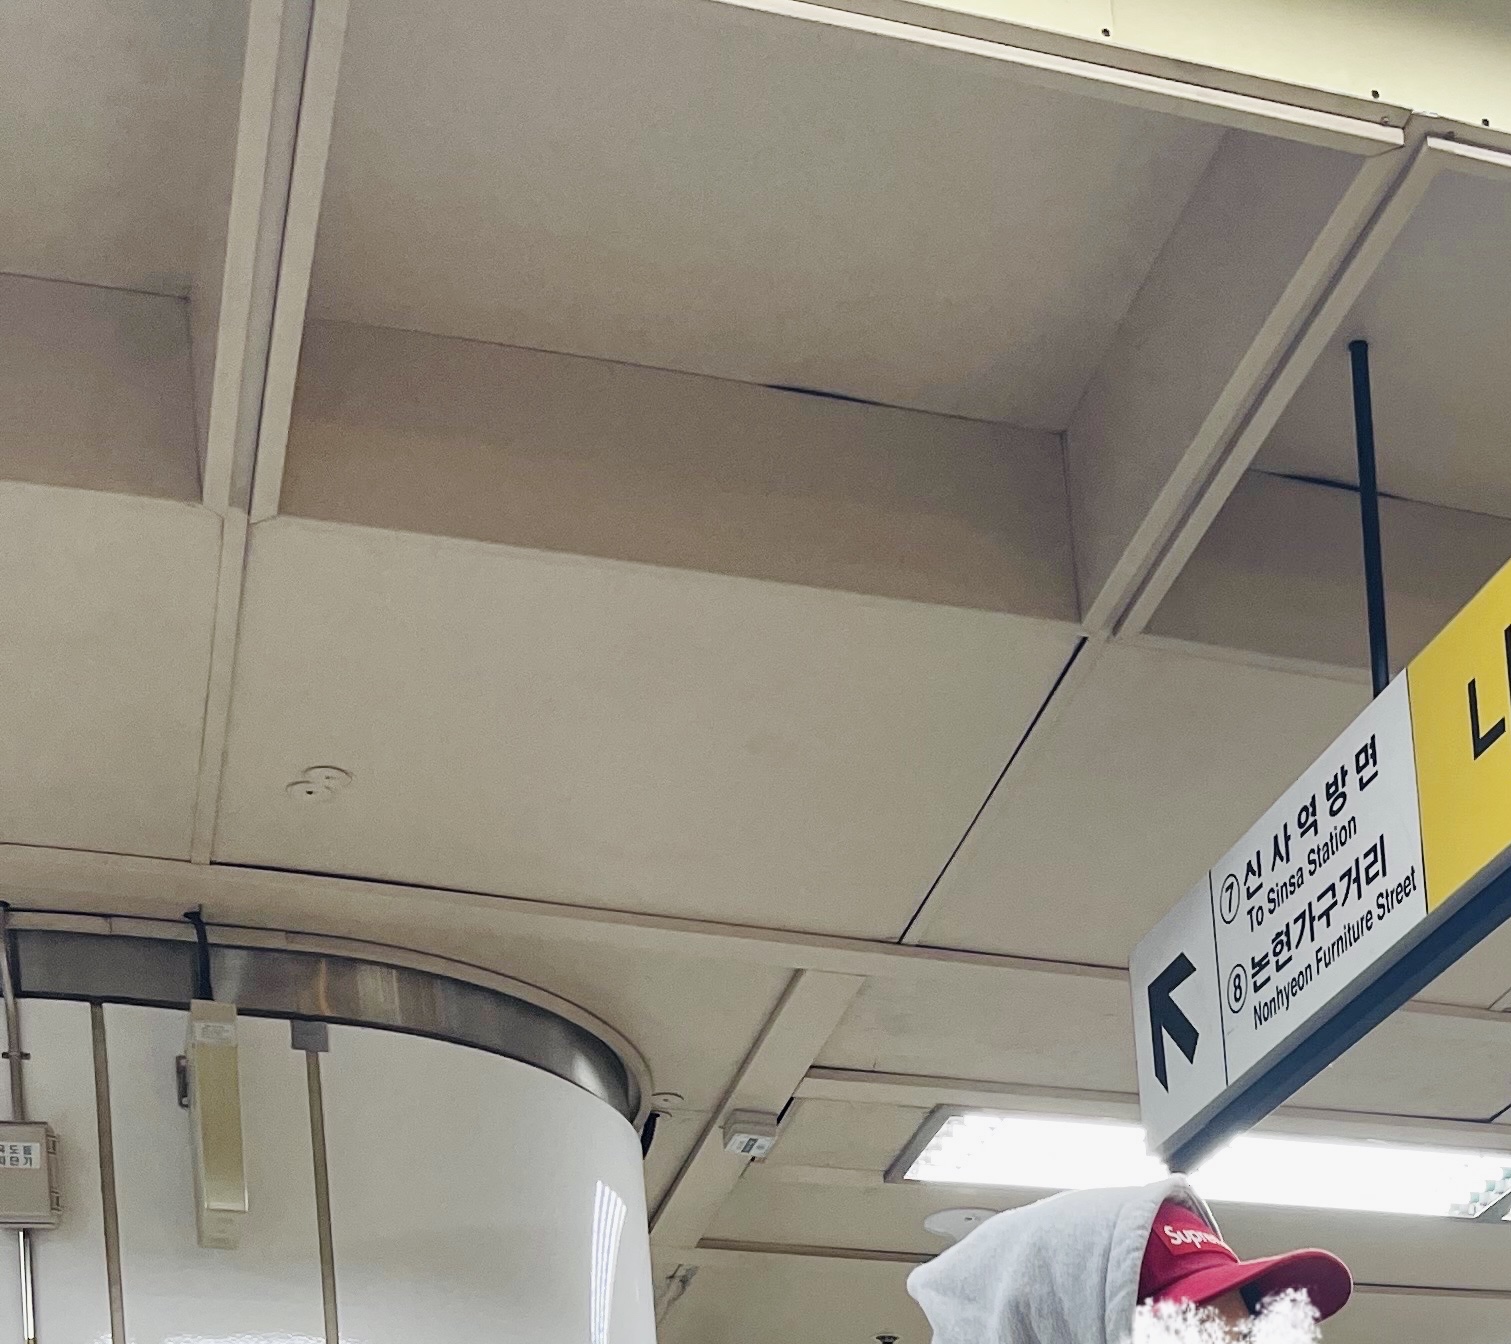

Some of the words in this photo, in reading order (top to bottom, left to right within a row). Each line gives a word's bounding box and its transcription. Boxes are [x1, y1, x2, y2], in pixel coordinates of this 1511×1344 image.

[1247, 905, 1265, 933] To
[1267, 866, 1305, 915] Sinsa
[1307, 816, 1357, 877] Station
[1251, 834, 1387, 994] 논현가구거리
[1253, 963, 1313, 1030] Nonhyeon
[1315, 909, 1373, 975] Furniture
[1376, 865, 1417, 921] Street
